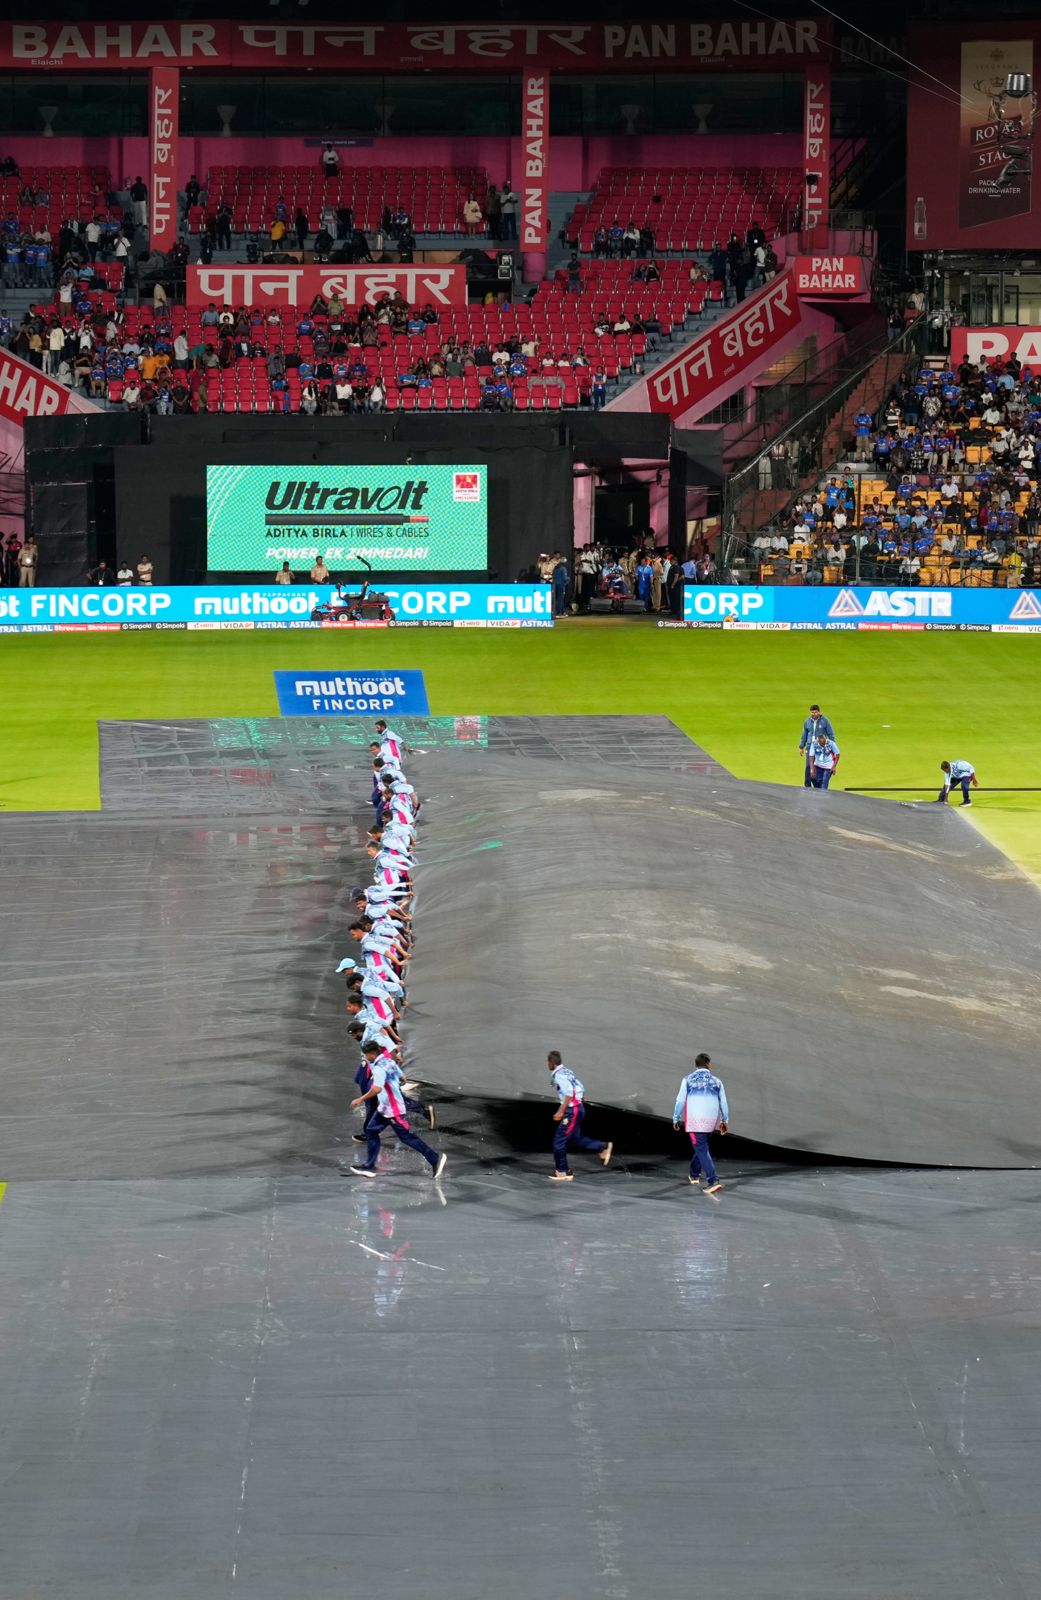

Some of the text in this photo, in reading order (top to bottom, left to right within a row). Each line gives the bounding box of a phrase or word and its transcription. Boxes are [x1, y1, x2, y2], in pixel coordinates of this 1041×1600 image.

[12, 24, 219, 58] BAHAR
[238, 25, 592, 57] पान बहार
[604, 20, 820, 58] PAN BAHAR
[806, 80, 825, 158] बहार
[153, 86, 173, 234] पान बहार
[525, 77, 545, 243] PAN BAHAR
[811, 257, 844, 272] PAN
[197, 269, 455, 305] पान बहार
[799, 274, 856, 288] BAHAR
[653, 278, 793, 406] पान बहार
[264, 481, 429, 511] Ultravolt
[265, 528, 430, 538] ADITYA BIRLA WIRES & CABLES
[266, 547, 429, 560] POWER EK ZIMMEDARI
[31, 593, 171, 617] FINCORP
[194, 592, 320, 615] muthoot
[21, 624, 53, 632] ASTRAL
[295, 677, 406, 696] muthoot
[312, 698, 394, 710] FINCORP
